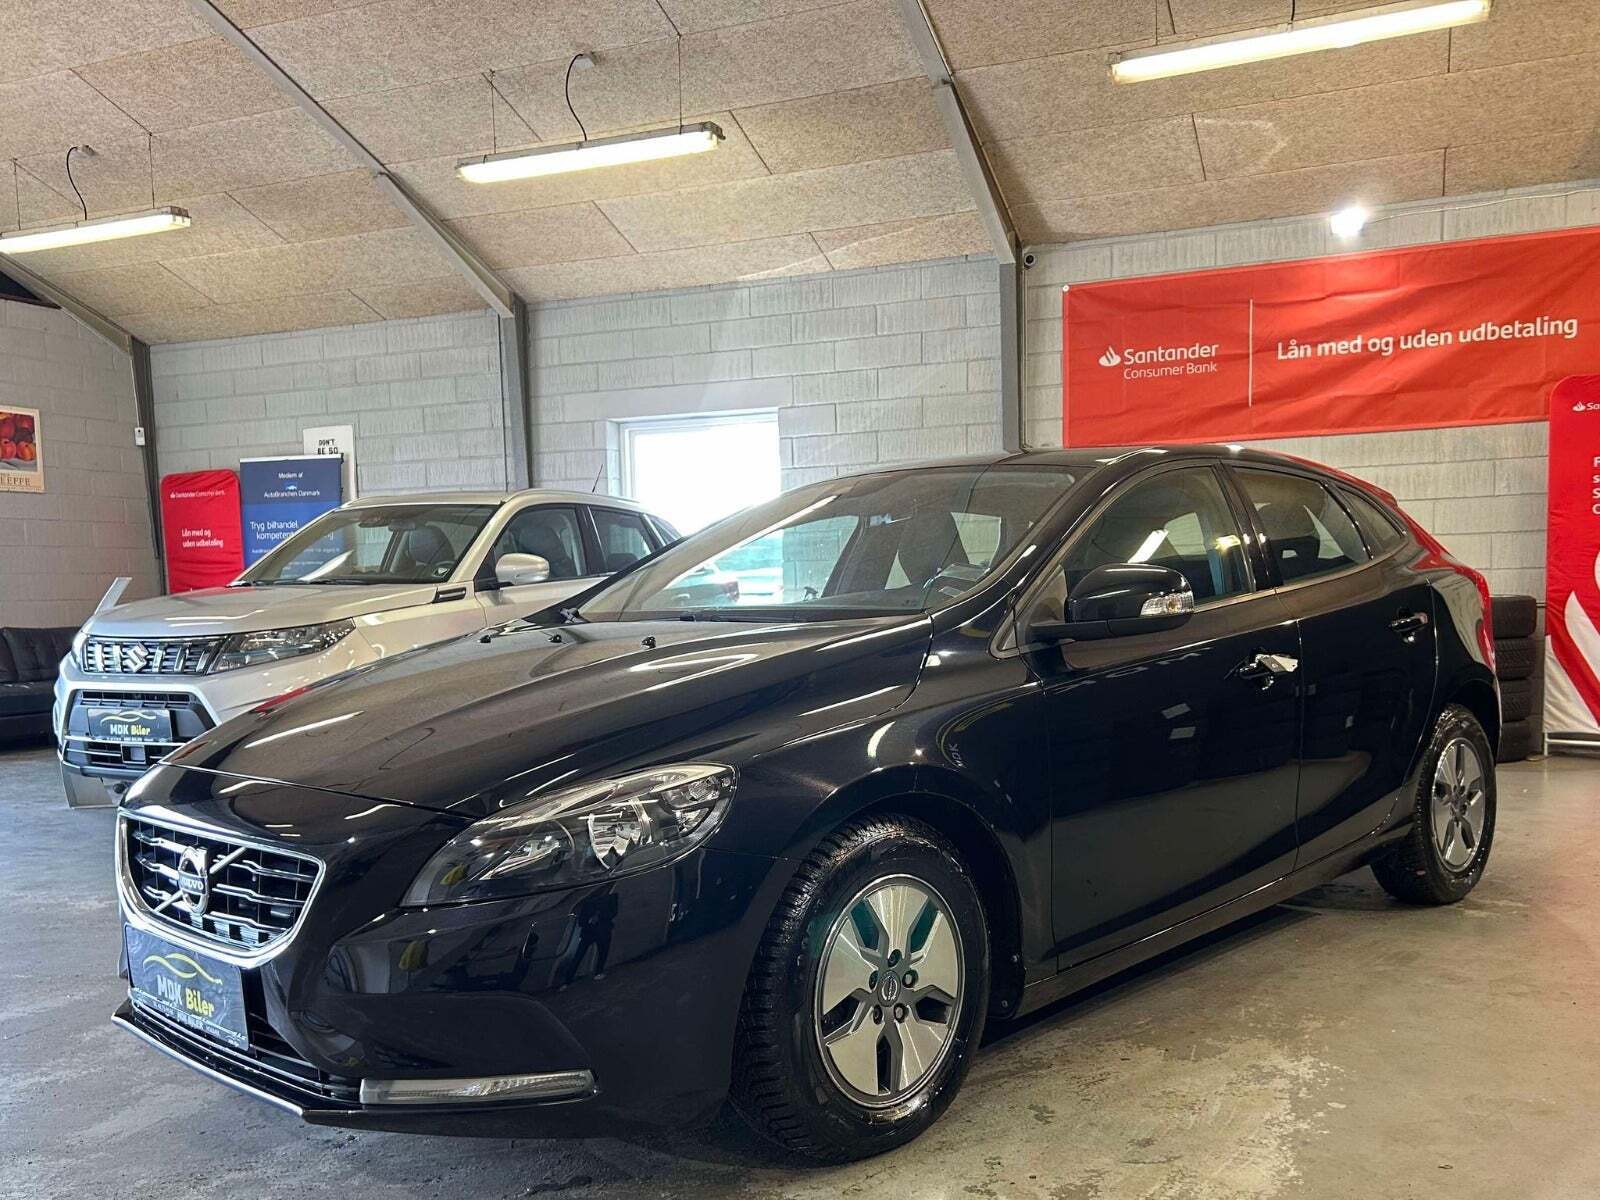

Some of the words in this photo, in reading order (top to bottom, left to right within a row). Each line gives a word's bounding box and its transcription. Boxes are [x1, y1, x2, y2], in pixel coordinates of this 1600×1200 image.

[1277, 339, 1312, 360] Lån
[1316, 335, 1362, 357] med
[1367, 336, 1394, 356] og
[1400, 329, 1453, 350] uden
[1458, 316, 1579, 343] udbetaling
[1124, 343, 1219, 365] Santander
[1124, 365, 1185, 380] Consumer
[1186, 362, 1218, 375] Bank
[317, 447, 327, 455] BE
[328, 447, 339, 455] SO
[298, 489, 320, 497] Danmark
[250, 521, 265, 531] Tryg
[110, 724, 129, 735] MDK
[130, 724, 151, 736] Biler
[156, 974, 183, 1006] MDK
[185, 987, 214, 1017] Biler
